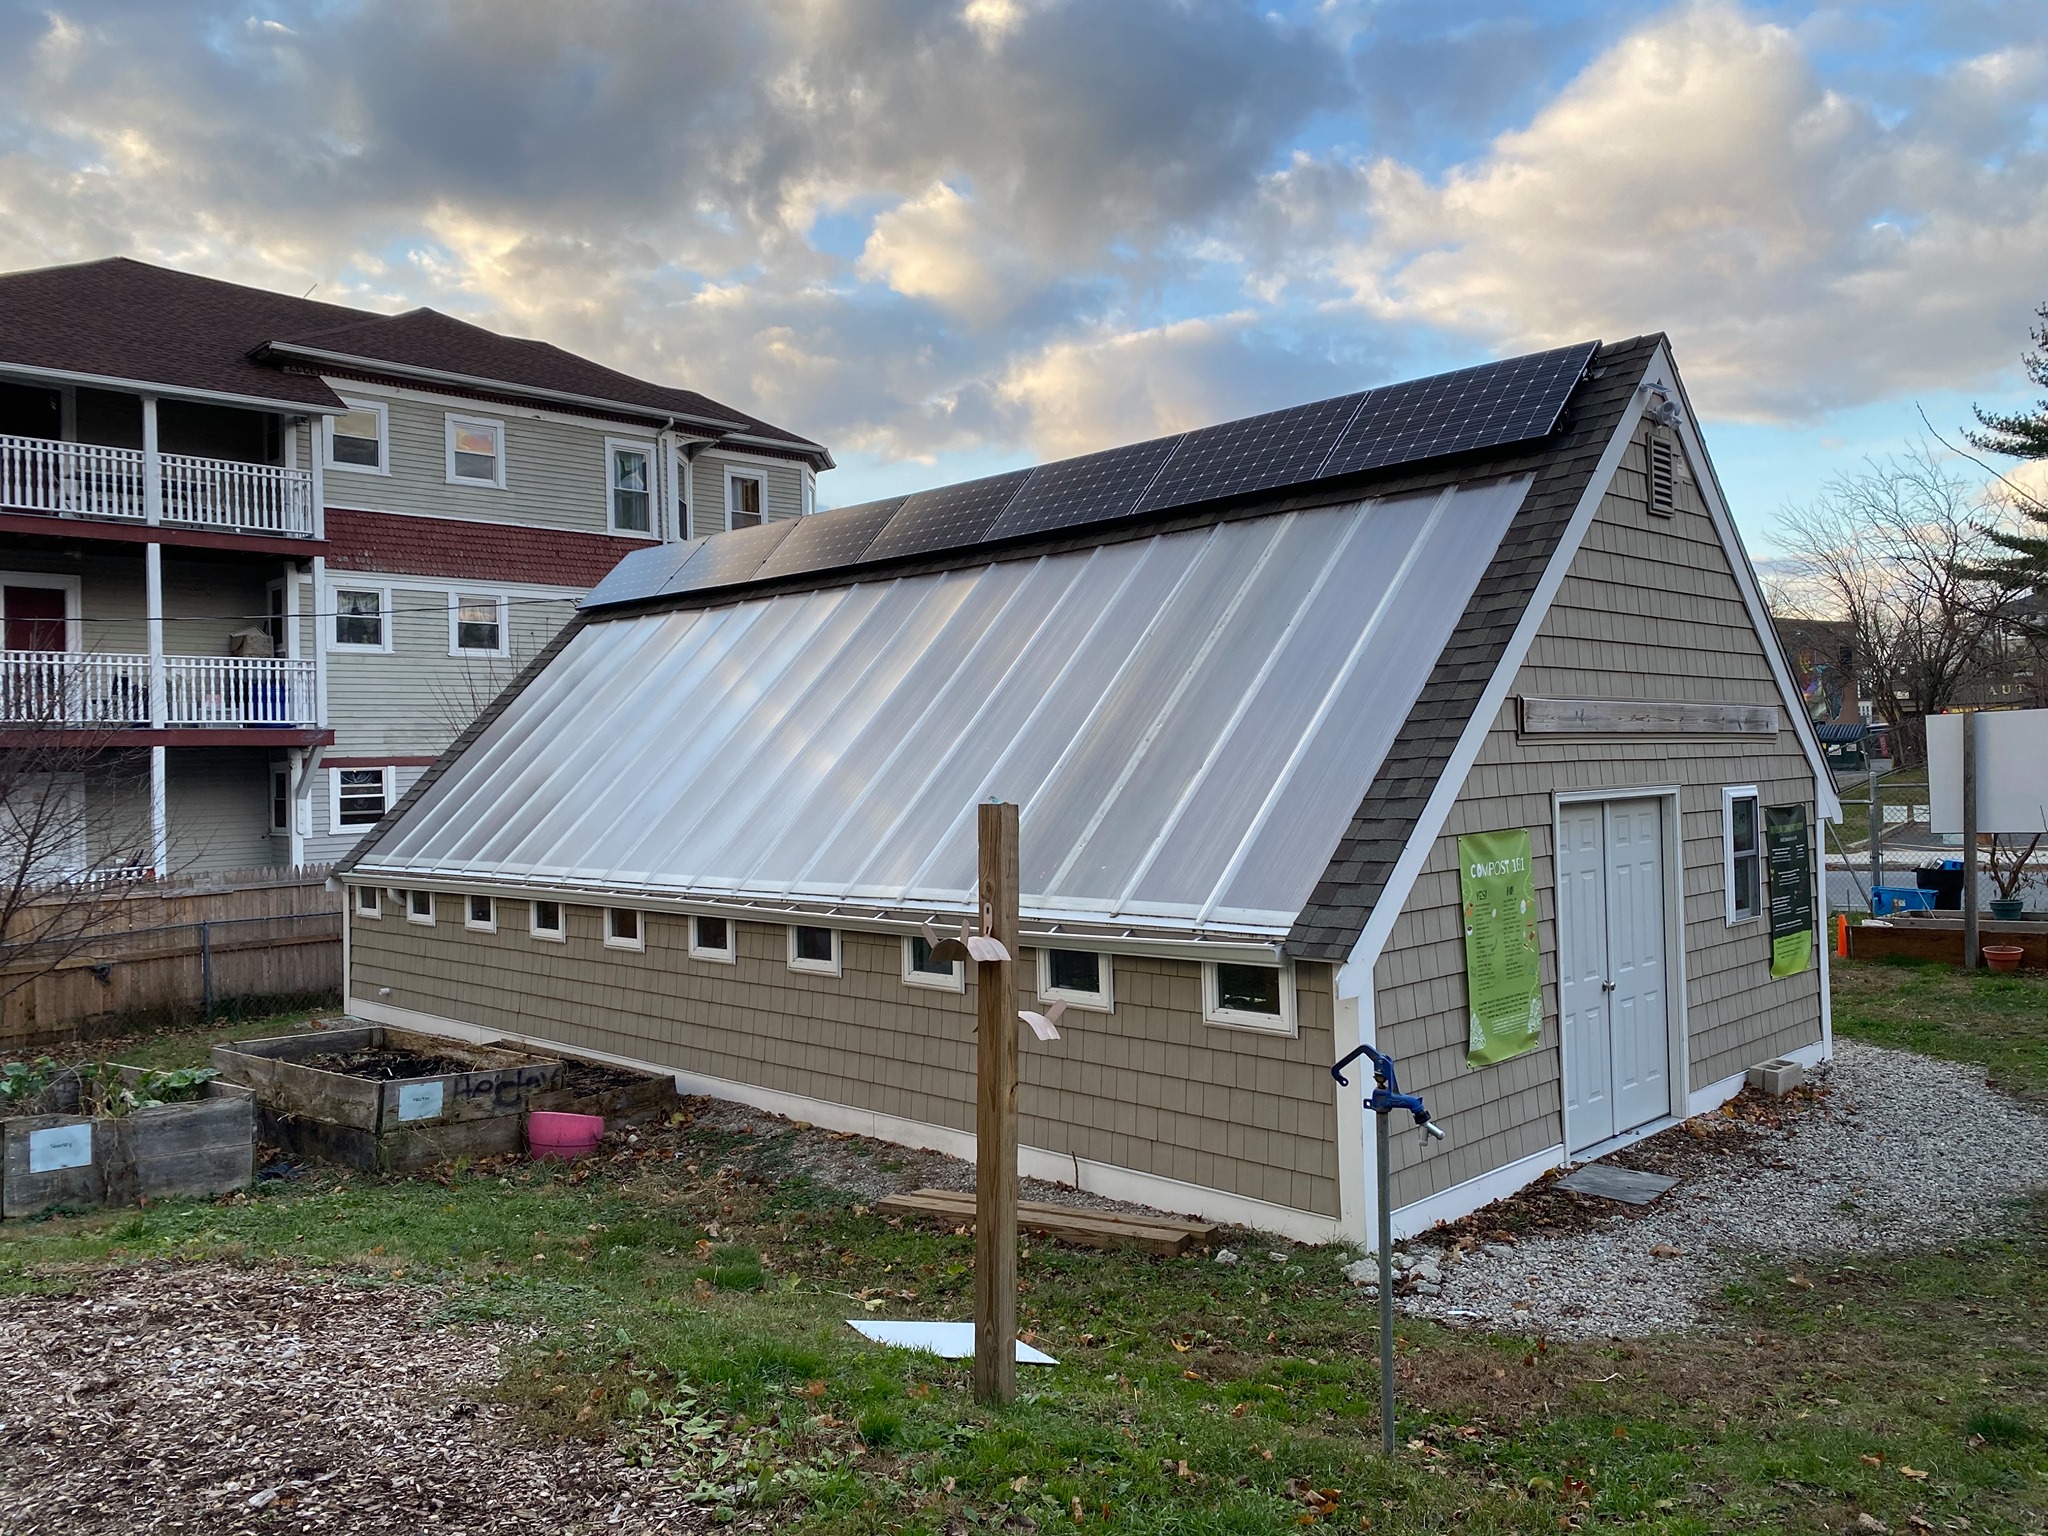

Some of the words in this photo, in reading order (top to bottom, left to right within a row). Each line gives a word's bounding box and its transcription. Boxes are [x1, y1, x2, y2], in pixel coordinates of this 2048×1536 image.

[1989, 684, 2032, 696] AUT
[1470, 859, 1509, 878] COMPOST
[1512, 857, 1525, 873] 101
